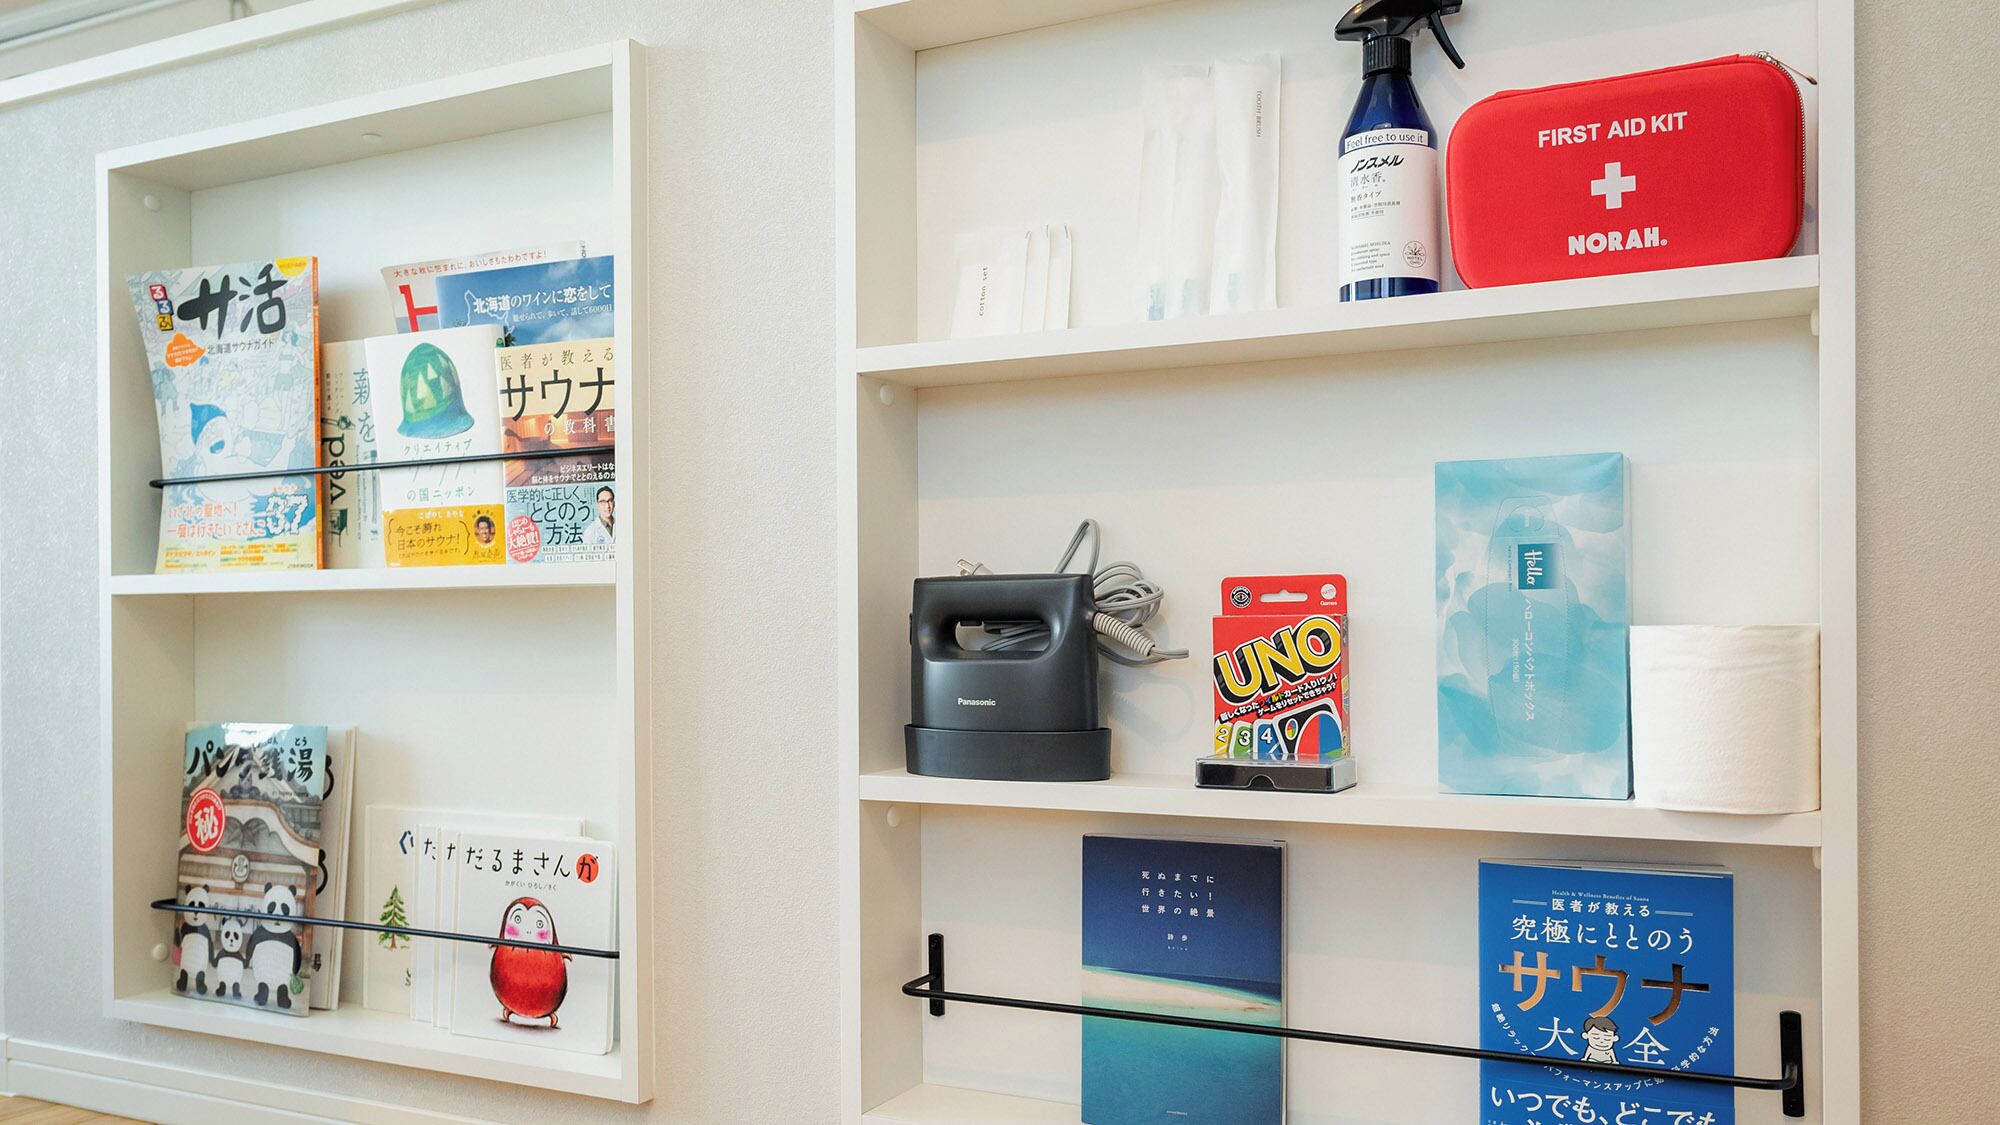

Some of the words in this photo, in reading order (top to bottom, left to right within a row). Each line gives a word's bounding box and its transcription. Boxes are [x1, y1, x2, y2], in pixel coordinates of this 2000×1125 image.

[1538, 123, 1601, 148] FIRST
[1607, 117, 1646, 139] AID
[1651, 111, 1688, 134] KIT
[1347, 137, 1363, 150] Feel
[1365, 134, 1384, 145] free
[1386, 133, 1397, 142] to
[1399, 134, 1416, 142] use
[1417, 133, 1423, 143] it
[1350, 155, 1405, 174] ノンスメル
[1568, 226, 1668, 256] NORAH.
[177, 263, 288, 340] サ活
[473, 282, 612, 314] 北海道のワインに恋をして
[500, 347, 614, 371] 医者が教える
[500, 367, 615, 421] サウナ
[506, 486, 580, 504] 医学的に正しく
[545, 522, 584, 545] 方法
[1523, 548, 1544, 586] Hello
[1214, 615, 1341, 705] UNO
[1523, 598, 1536, 722] ハローコンパクトボックス
[957, 697, 997, 706] Panasonic
[1216, 727, 1230, 743] 2
[1239, 730, 1251, 746] 3
[1261, 727, 1273, 744] 4
[195, 806, 219, 845] 秘
[466, 846, 599, 881] だるまさんが
[1141, 870, 1215, 884] 死ぬまでに
[1141, 887, 1213, 901] 行きたい!
[1551, 889, 1570, 897] Health
[1141, 904, 1215, 918] 世界の絶景
[1551, 898, 1650, 918] 医者が教える
[1510, 914, 1694, 955] 究極にととのう
[1499, 950, 1711, 1026] サウナ
